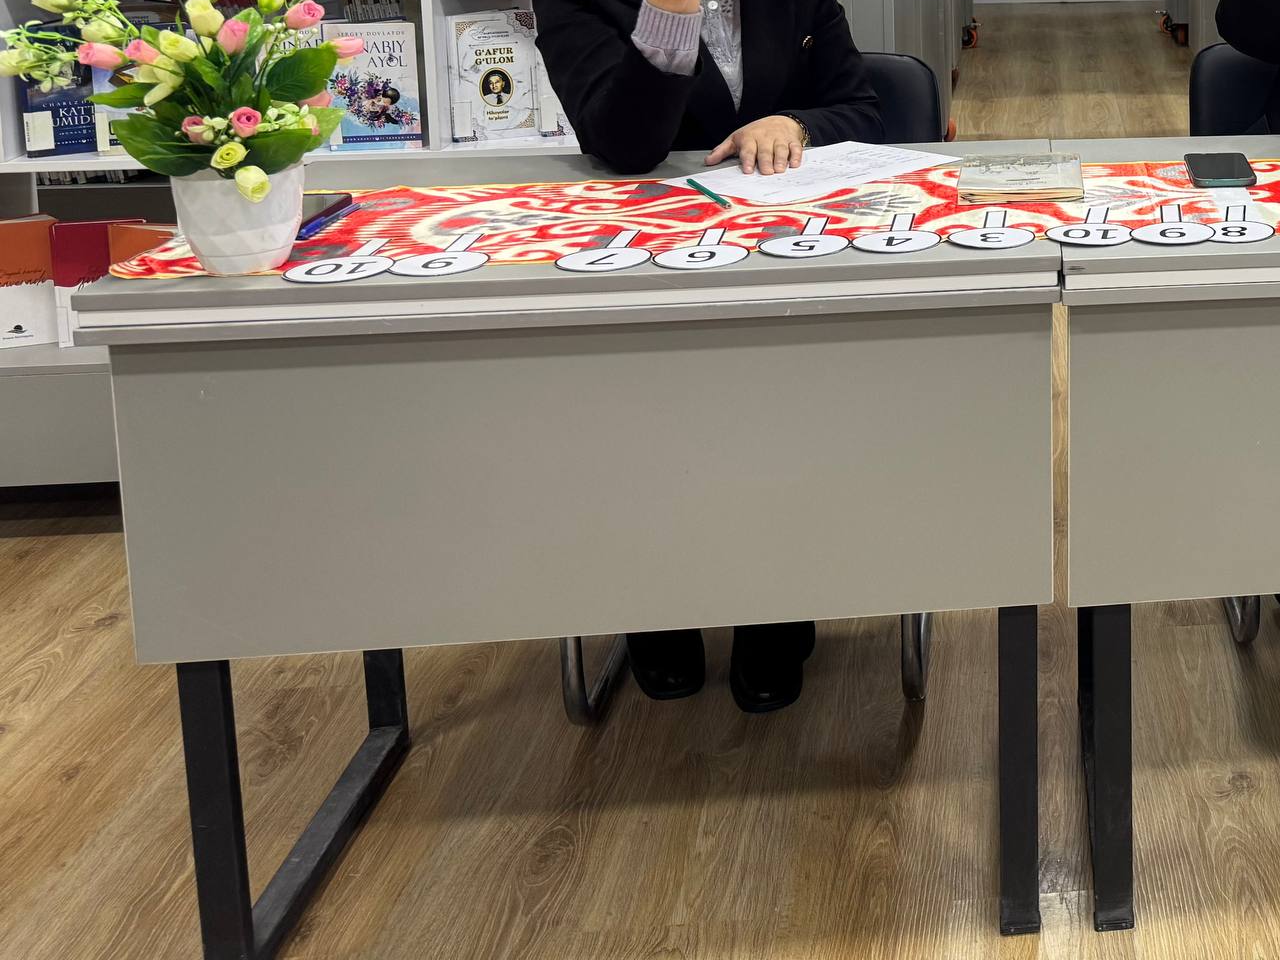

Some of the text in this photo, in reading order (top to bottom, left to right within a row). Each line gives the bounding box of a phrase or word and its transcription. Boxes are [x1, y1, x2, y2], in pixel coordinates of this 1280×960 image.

[367, 55, 408, 68] AYOL
[979, 232, 1004, 243] 3
[1062, 227, 1121, 240] 10
[1158, 226, 1187, 239] 9
[1220, 225, 1248, 237] 8
[792, 240, 816, 252] 5
[881, 237, 913, 249] 4
[421, 256, 459, 269] 9
[585, 252, 623, 266] 7
[686, 250, 717, 263] 6
[304, 261, 372, 276] 10
